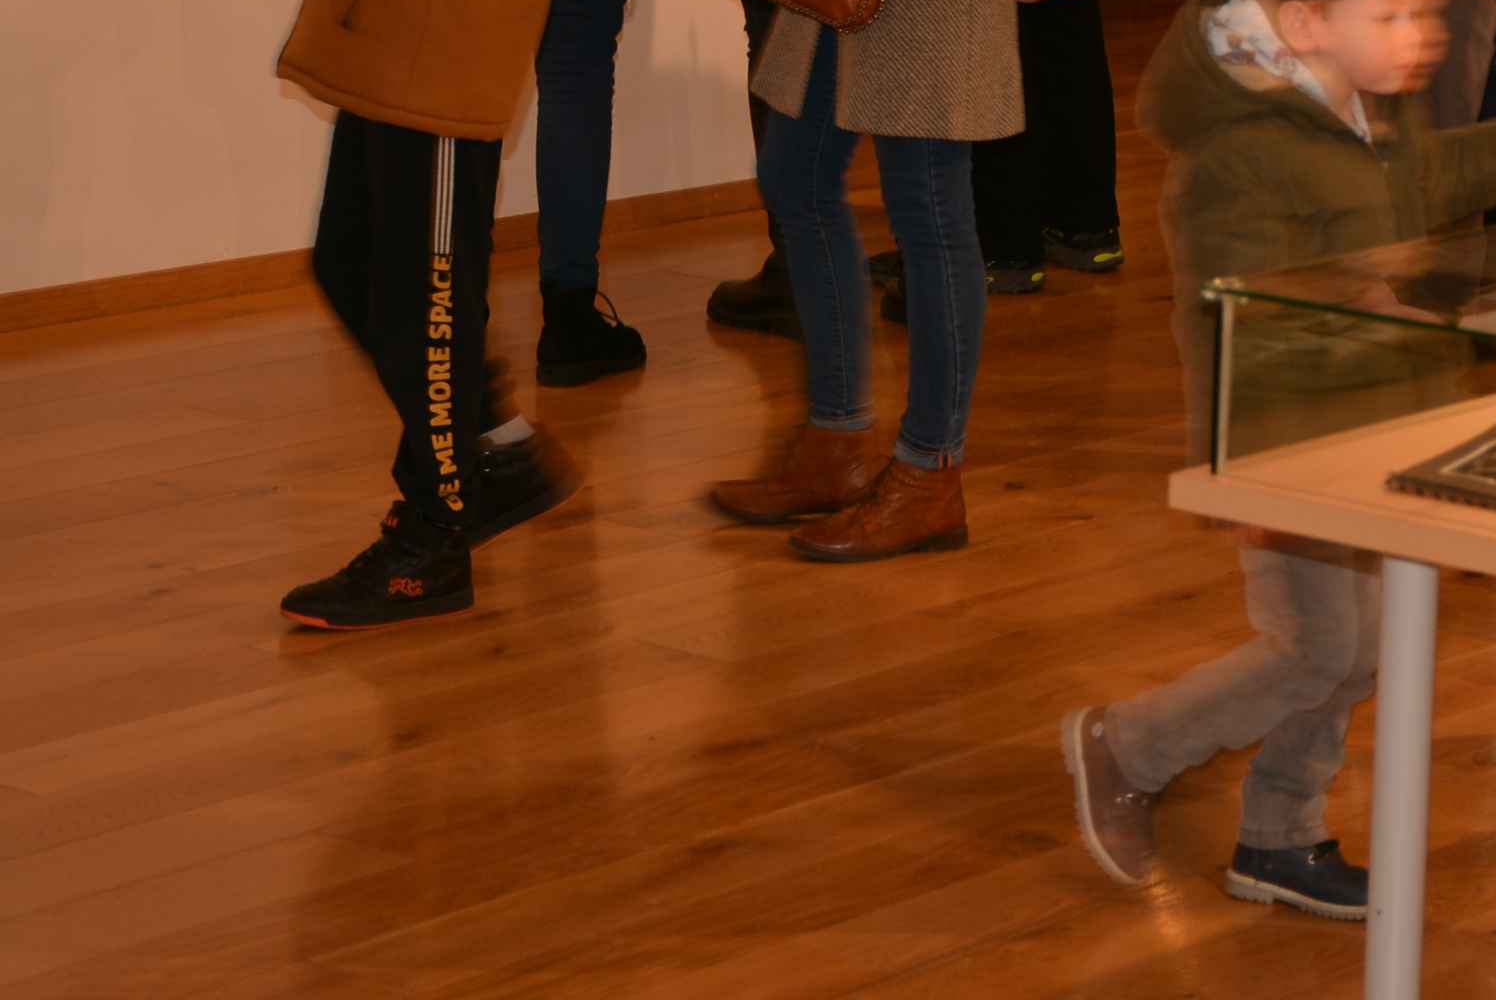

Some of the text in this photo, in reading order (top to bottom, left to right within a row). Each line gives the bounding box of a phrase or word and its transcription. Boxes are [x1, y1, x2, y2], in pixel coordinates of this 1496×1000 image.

[428, 255, 453, 340] SPACE
[427, 346, 453, 426] MORE
[431, 431, 458, 475] ME
